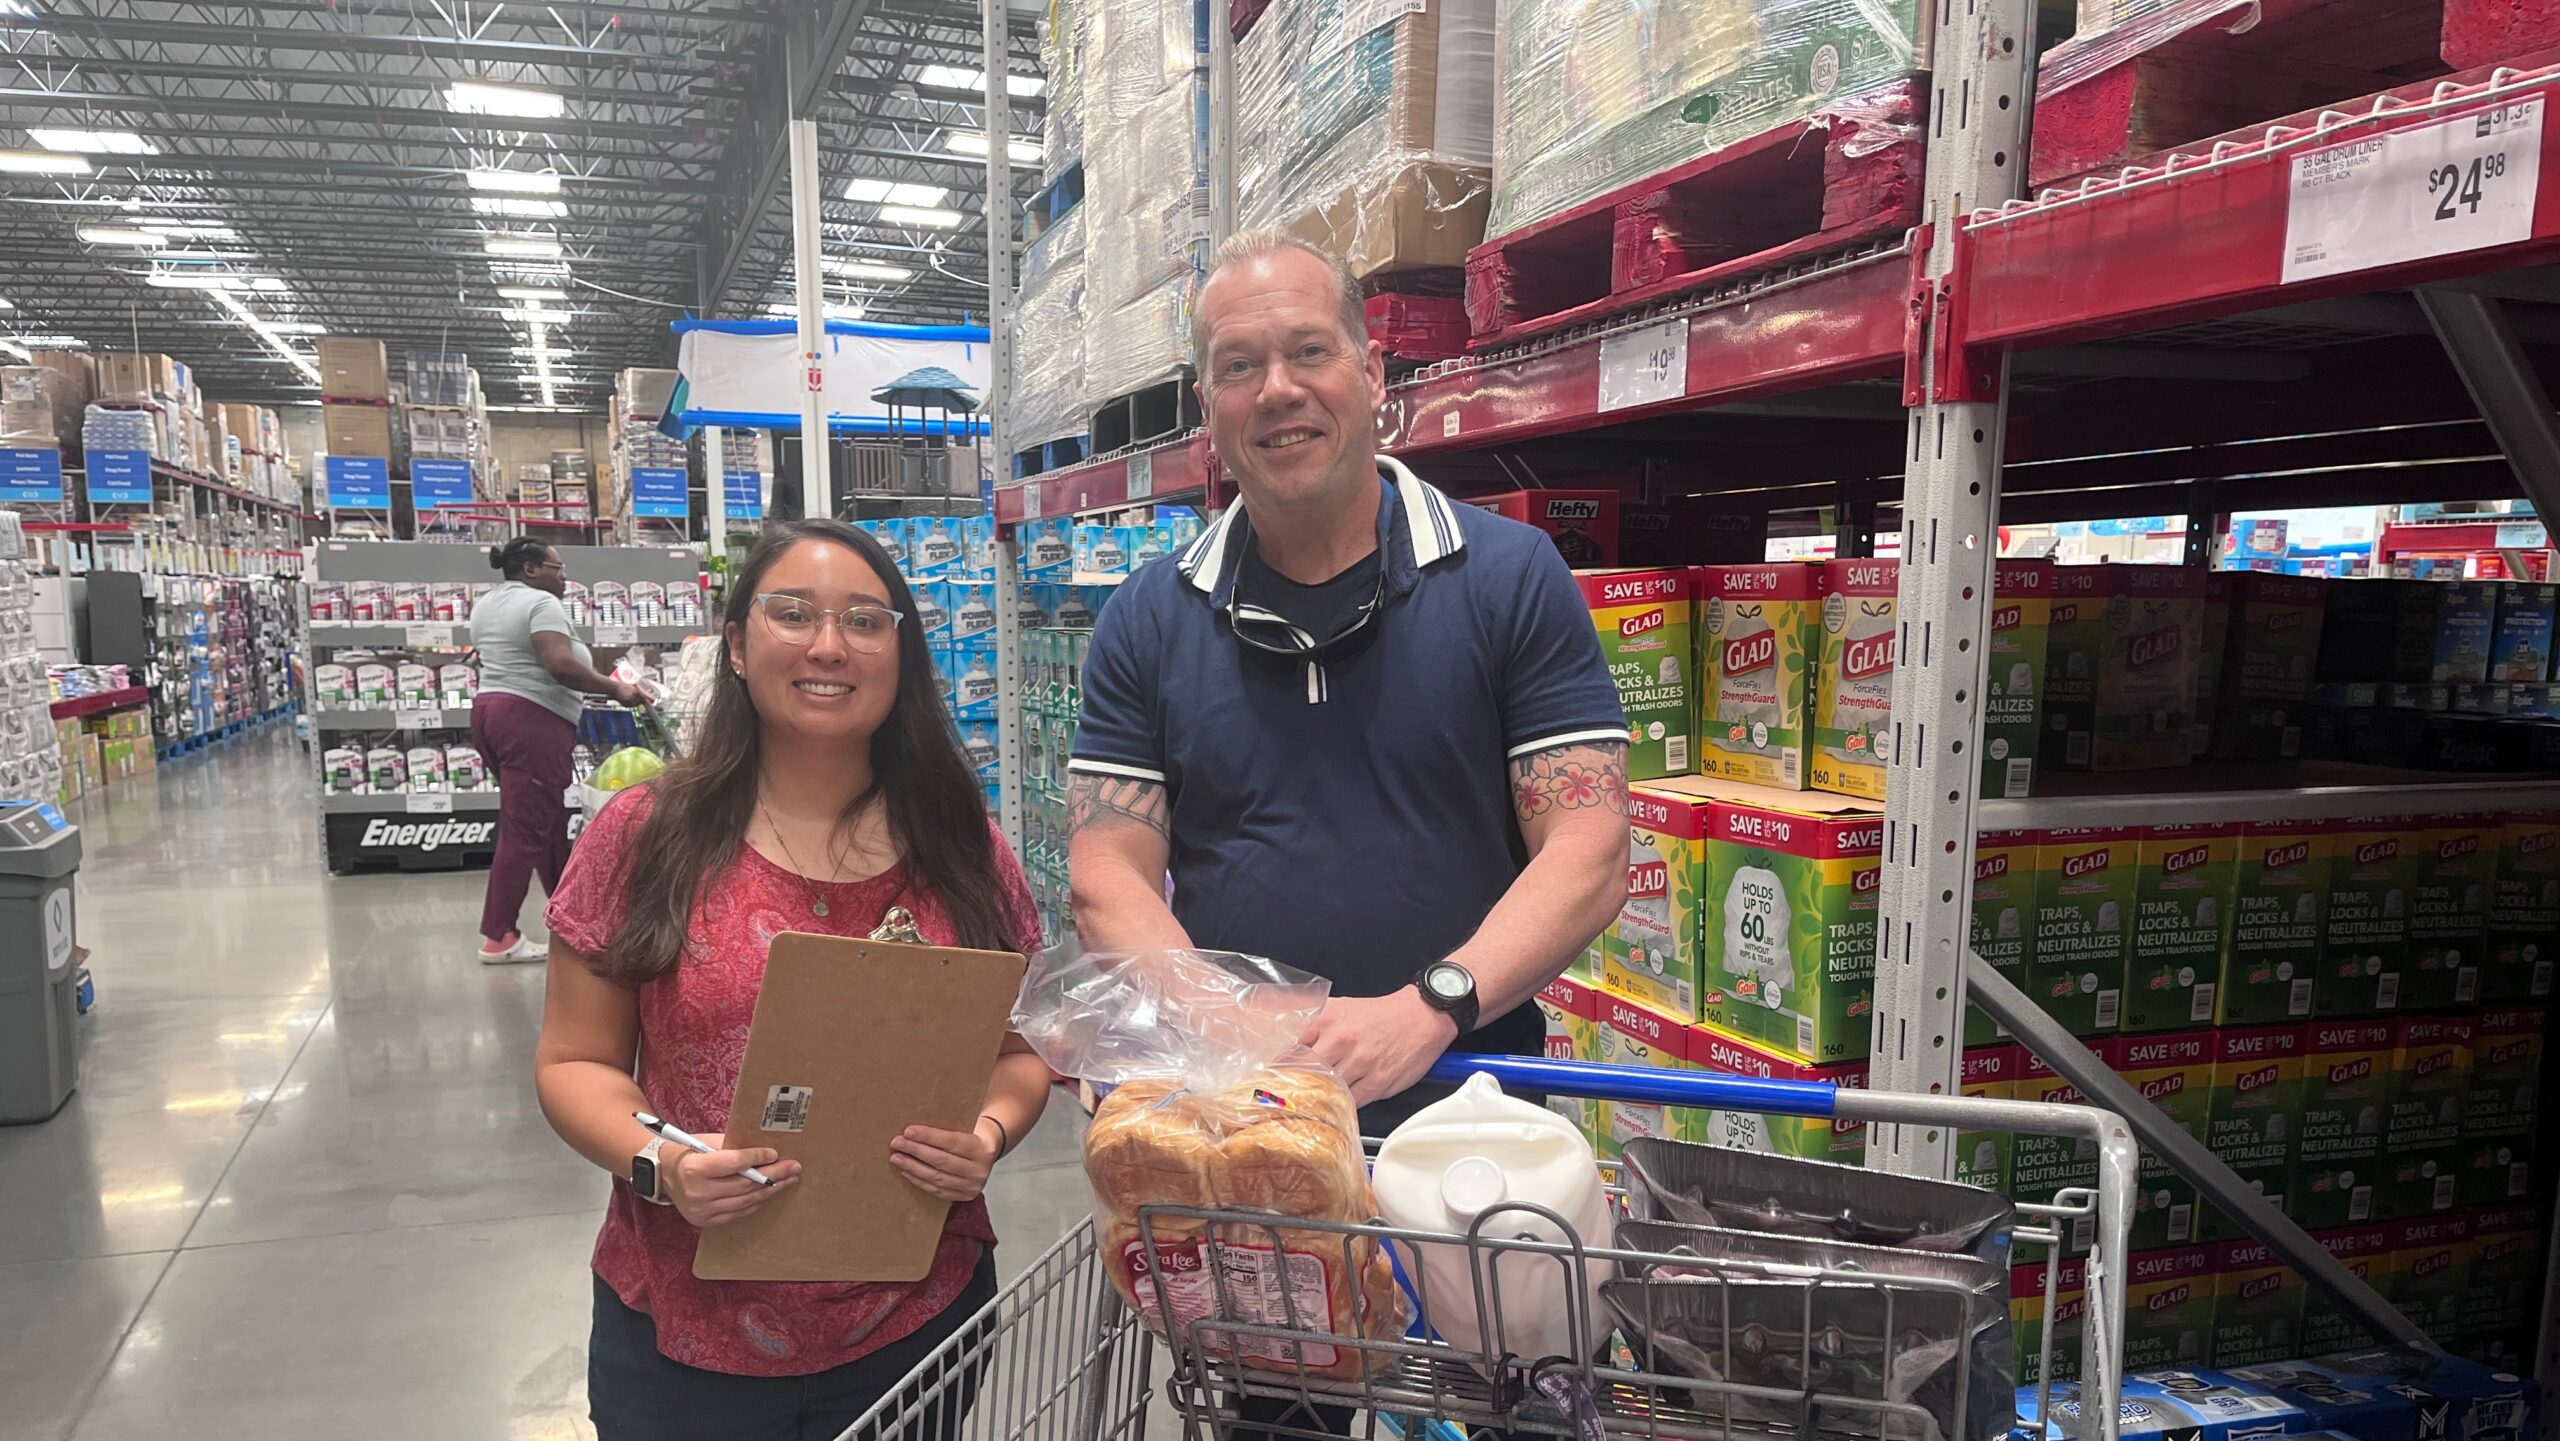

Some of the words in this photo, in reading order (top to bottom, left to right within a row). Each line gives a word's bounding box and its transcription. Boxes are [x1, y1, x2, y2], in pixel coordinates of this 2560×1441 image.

[1817, 62, 1831, 79] USA
[2303, 155, 2313, 168] 55
[2314, 150, 2332, 166] GAL
[2332, 146, 2357, 163] DRUM
[2358, 139, 2384, 156] LINER
[2302, 161, 2345, 179] MEMBER'S
[2346, 155, 2370, 169] MARK
[2312, 177, 2323, 187] CT
[2325, 171, 2352, 184] BLACK
[1549, 501, 1597, 520] Hefty
[925, 542, 953, 552] POWER
[1037, 544, 1065, 553] POWER
[929, 551, 949, 560] FLEX
[1041, 552, 1062, 562] FLEX
[1724, 573, 1751, 590] SAVE
[1847, 567, 1880, 586] SAVE
[1604, 581, 1643, 600] SAVE
[961, 611, 992, 621] POWER
[1623, 612, 1662, 636] GLAD
[966, 620, 987, 630] FLEX
[934, 631, 949, 639] 200
[1726, 638, 1773, 671] GLAD
[2131, 632, 2177, 665] GLAD
[1608, 661, 1644, 676] RAPS,
[1644, 675, 1654, 687] &
[1732, 679, 1761, 691] ForceFlex
[1853, 683, 1887, 695] ForceFlex
[1620, 686, 1684, 704] UTRALIZES
[1721, 690, 1776, 704] StrengthGuard
[1632, 702, 1655, 712] TRASH
[1656, 699, 1683, 709] ODORS
[2001, 714, 2032, 723] ODORS
[1703, 759, 1716, 773] 160
[1813, 769, 1829, 785] 160
[1730, 814, 1762, 837] SAVE
[361, 818, 495, 851] Energizer
[1837, 830, 1880, 849] SAVE
[2267, 844, 2307, 867] GLAD
[2359, 841, 2397, 863] GLAD
[2440, 838, 2477, 858] GLAD
[2066, 853, 2107, 876] GLAD
[2166, 849, 2207, 871] GLAD
[1628, 865, 1665, 894] GLAD
[1742, 882, 1774, 900] HOLDS
[2333, 891, 2372, 905] TRAPS,
[1743, 899, 1756, 911] UP
[1759, 902, 1772, 914] TO
[2140, 901, 2182, 915] TRAPS,
[2242, 897, 2281, 910] TRAPS,
[2039, 906, 2083, 921] TRAPS,
[2239, 912, 2279, 925] LOCKS
[2281, 911, 2289, 923] &
[2330, 907, 2369, 920] LOCKS
[1621, 911, 1669, 935] StrengthGuard
[1740, 913, 1765, 942] 60
[1764, 936, 1774, 946] LBS
[1829, 921, 1876, 938] TRAPS,
[2038, 923, 2079, 937] LOCKS
[2082, 922, 2092, 933] &
[2139, 918, 2178, 931] LOCKS
[2181, 916, 2190, 928] &
[2329, 920, 2404, 935] NEUTRALIZES
[2137, 930, 2218, 947] NEUTRALIZES
[2237, 925, 2317, 941] NEUTRALIZES
[1744, 943, 1770, 955] WITHOUT
[1830, 939, 1874, 955] LOCKS
[2037, 934, 2121, 952] NEUTRALIZES
[1739, 950, 1752, 959] RIPS
[1757, 954, 1774, 966] TEARS
[2037, 953, 2065, 964] TOUGH
[2066, 951, 2091, 962] TRASH
[2091, 949, 2120, 960] ODORS
[1607, 972, 1619, 987] 160
[1830, 971, 1859, 982] TOUGH
[1736, 980, 1757, 996] Gain
[1706, 994, 1722, 1003] GLAD
[1612, 1005, 1638, 1029] SAVE
[1706, 1008, 1722, 1024] 160
[2227, 1037, 2263, 1054] SAVE
[2319, 1030, 2356, 1046] SAVE
[1711, 1042, 1743, 1070] SAVE
[1824, 1043, 1844, 1055] 160
[2129, 1042, 2167, 1061] SAVE
[2331, 1062, 2370, 1083] GLAD
[2417, 1054, 2450, 1076] GLAD
[2142, 1077, 2182, 1098] GLAD
[2238, 1069, 2277, 1091] GLAD
[1724, 1111, 1756, 1133] HOLDS
[1726, 1125, 1739, 1138] UP
[1740, 1128, 1754, 1145] TO
[2303, 1125, 2341, 1138] LOCKS
[2018, 1136, 2060, 1152] TRAPS,
[2302, 1137, 2378, 1153] NEUTRALIZES
[2017, 1153, 2057, 1168] LOCKS
[2060, 1152, 2069, 1162] &
[2016, 1163, 2098, 1183] NEUTRALIZES
[2016, 1182, 2043, 1193] TOUGH
[2044, 1179, 2068, 1190] TRASH
[2069, 1176, 2096, 1188] ODORS
[2405, 1225, 2437, 1241] SAVE
[1134, 1252, 1169, 1271] Sra
[1172, 1252, 1195, 1267] Lee
[1234, 1251, 1255, 1261] Facts
[2231, 1247, 2266, 1263] SAVE
[2136, 1260, 2172, 1276] SAVE
[2416, 1254, 2449, 1275] GLAD
[1242, 1274, 1257, 1282] 150
[2037, 1268, 2074, 1288] SVE
[2242, 1276, 2279, 1297] GLAD
[2149, 1288, 2188, 1311] GLAD
[2124, 1353, 2160, 1367] LOCKS
